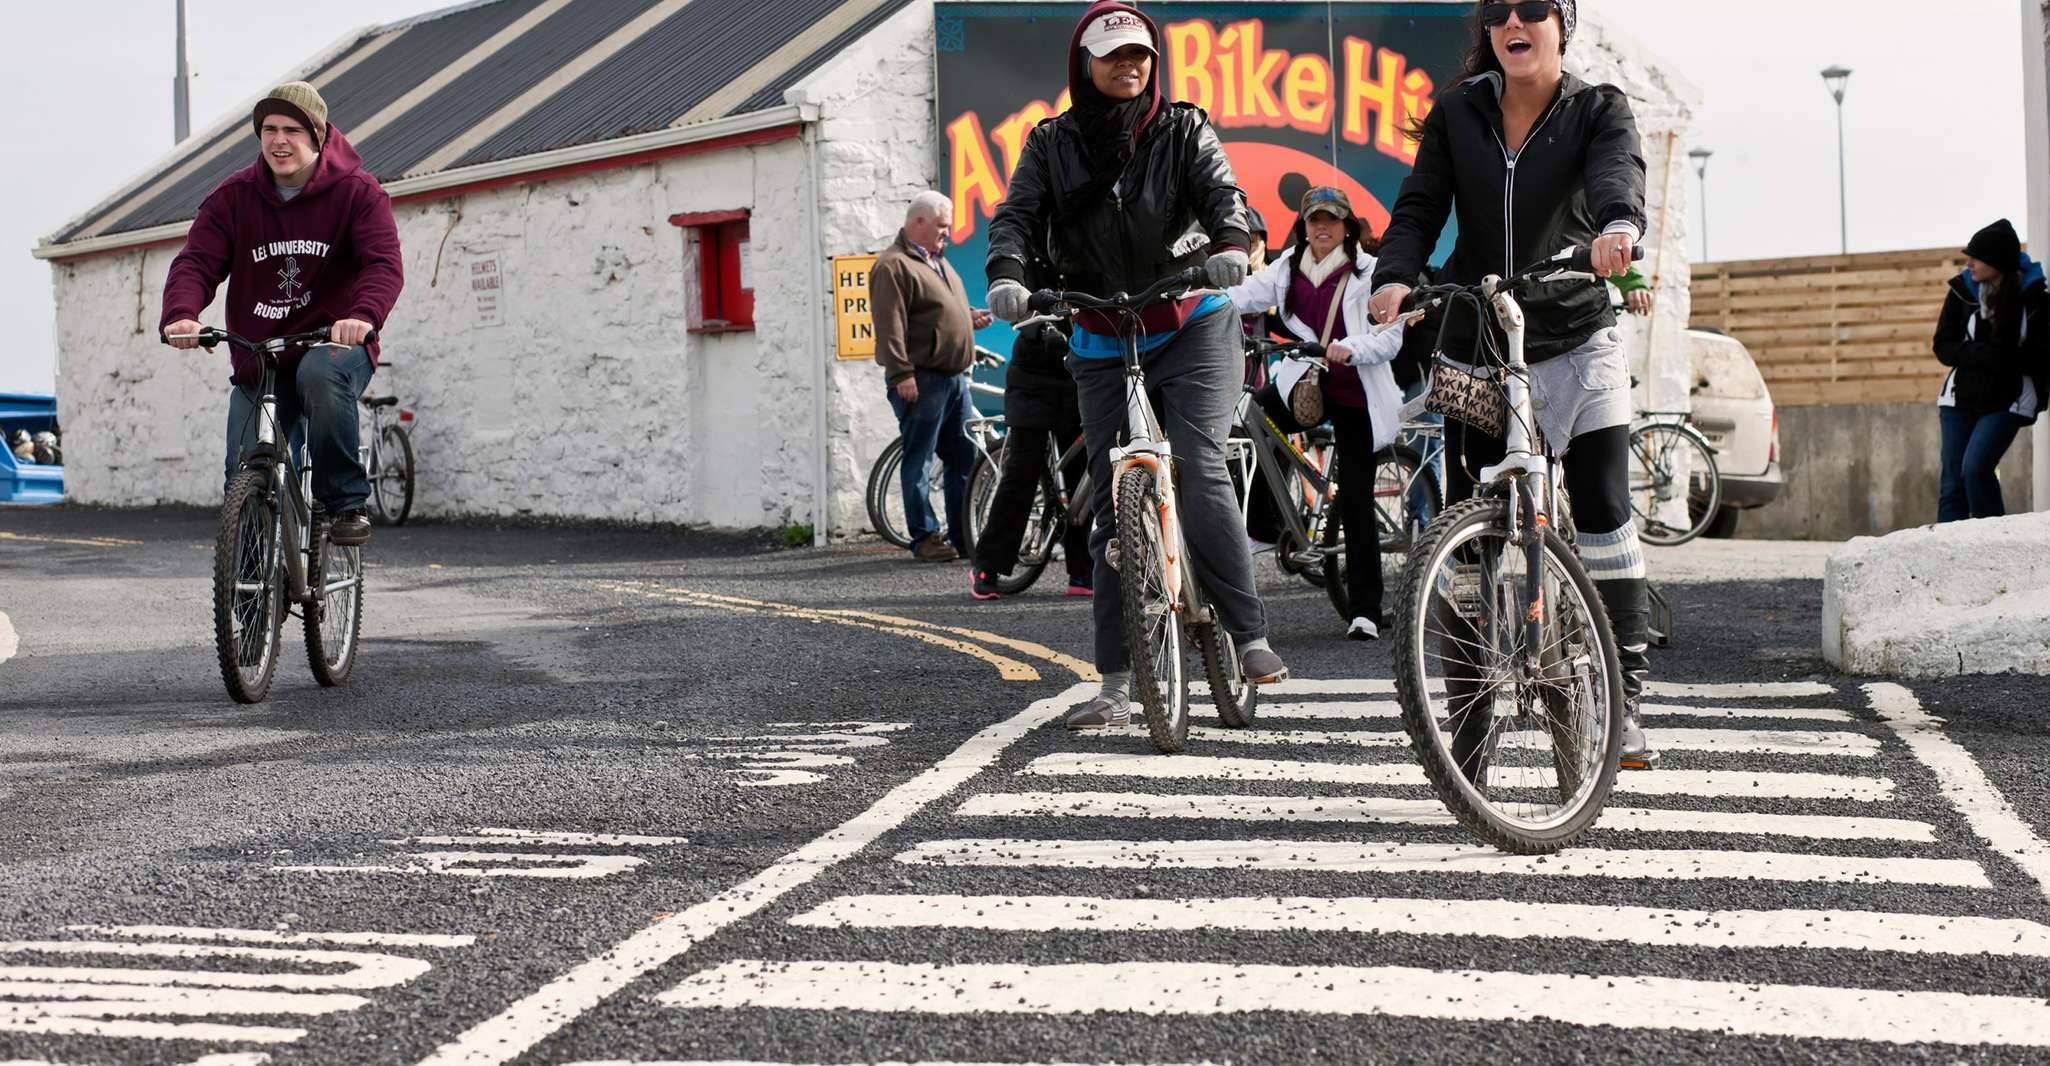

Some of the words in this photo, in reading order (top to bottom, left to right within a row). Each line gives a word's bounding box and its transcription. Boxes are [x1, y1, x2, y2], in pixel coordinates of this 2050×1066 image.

[1164, 17, 1335, 136] Bike
[1342, 35, 1435, 168] Hi
[269, 240, 331, 258] UNVERSITY
[840, 272, 865, 288] HE
[253, 302, 291, 320] RUGBY
[843, 298, 868, 314] PR
[851, 323, 873, 340] IN
